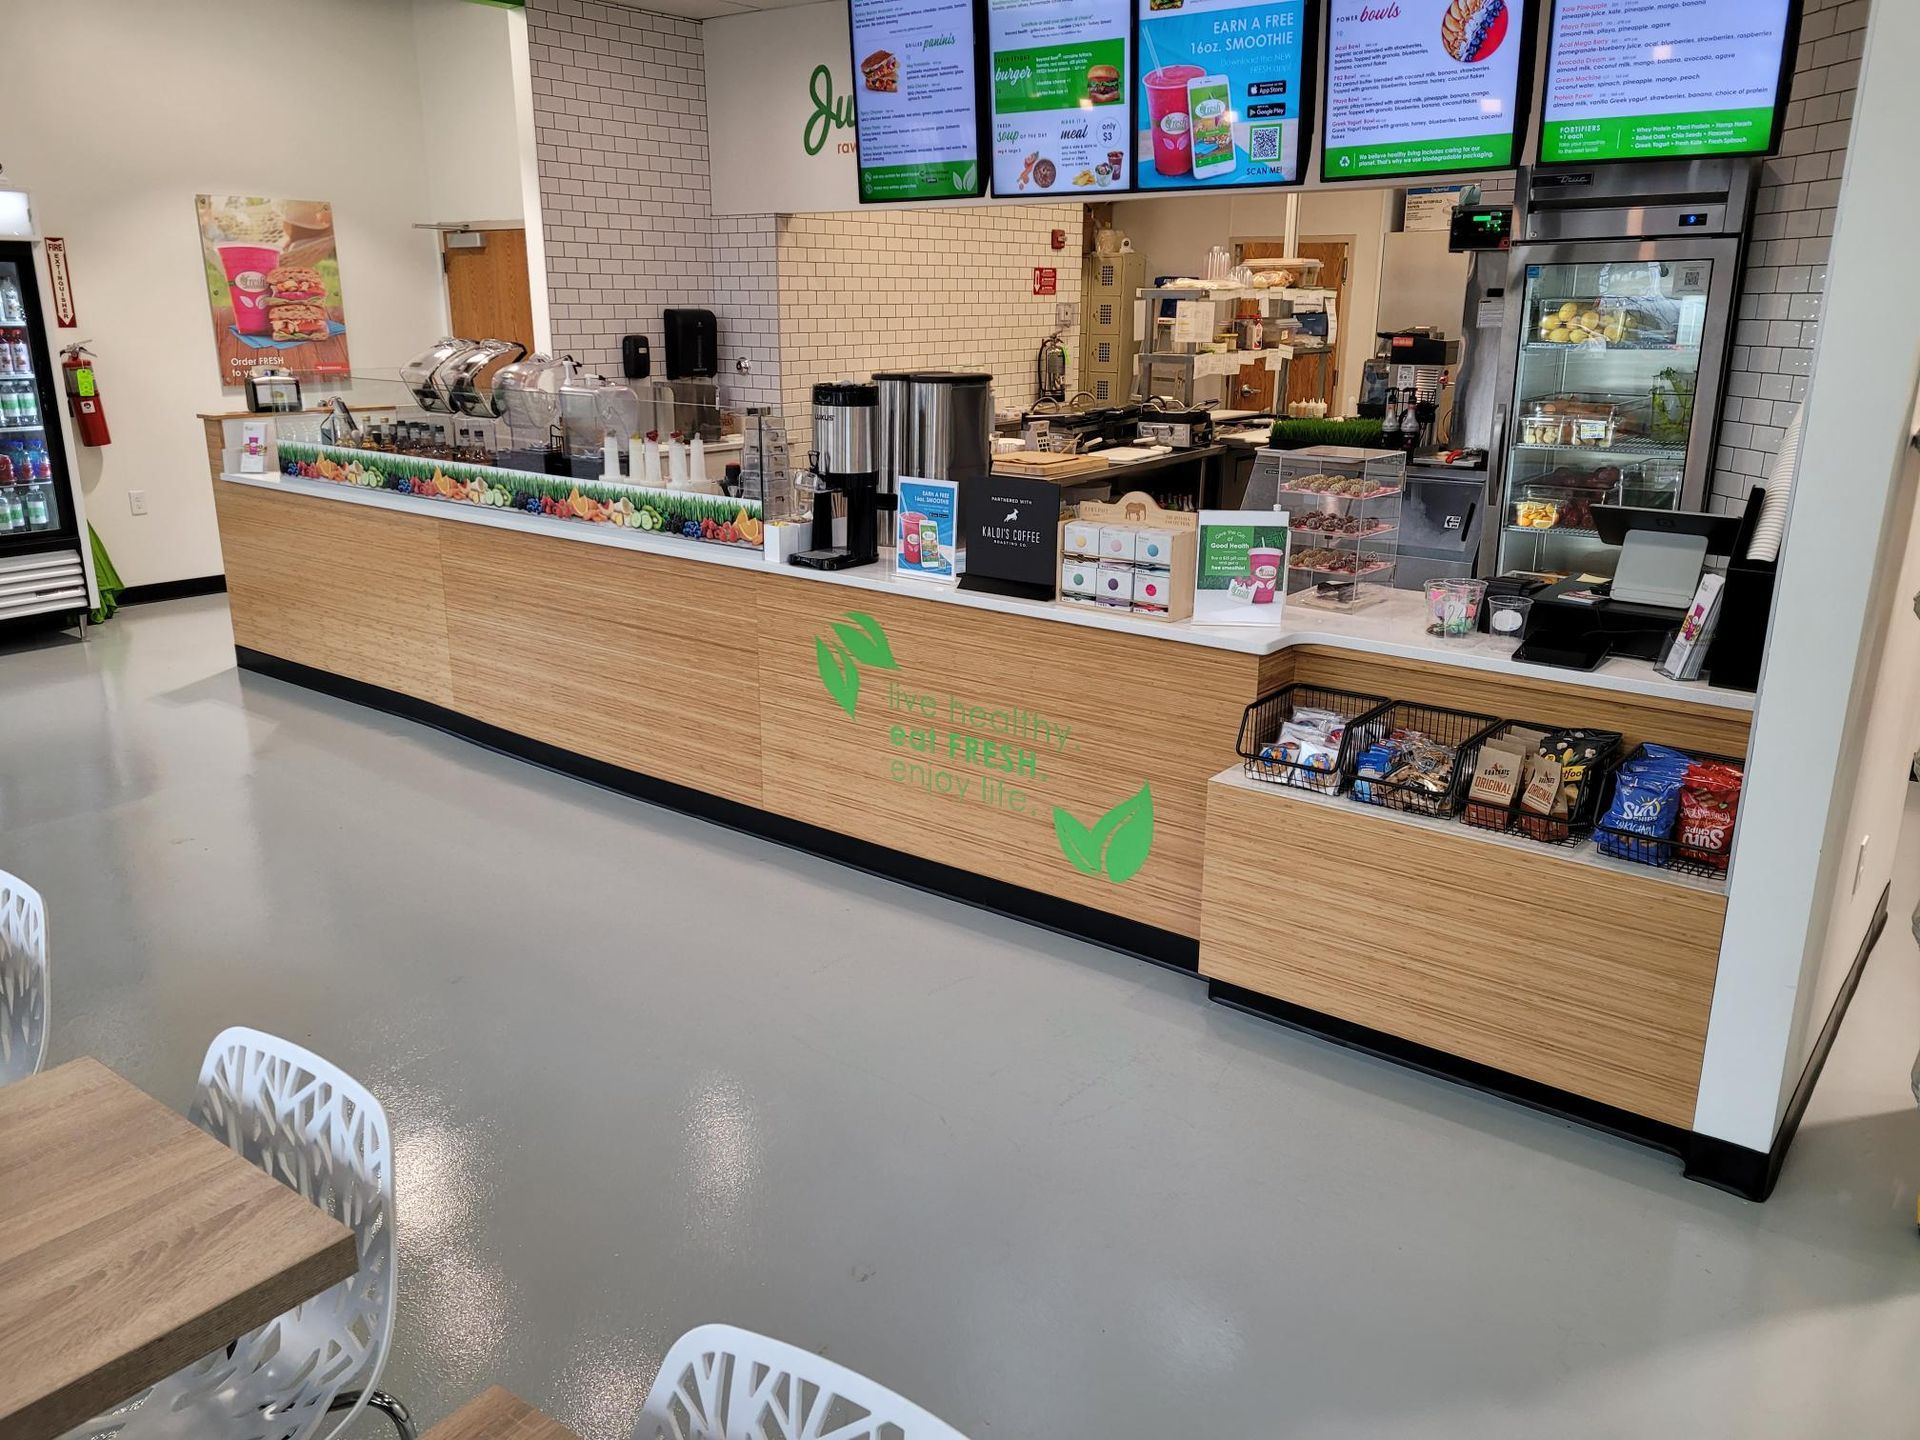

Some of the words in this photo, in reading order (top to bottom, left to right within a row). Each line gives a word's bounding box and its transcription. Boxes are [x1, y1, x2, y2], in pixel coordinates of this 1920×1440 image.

[1360, 2, 1401, 23] bowls
[1562, 10, 1591, 20] pineapple
[1214, 19, 1247, 34] EARN
[1251, 19, 1261, 29] A
[1265, 12, 1294, 27] FREE
[923, 33, 955, 51] paninis
[1191, 40, 1221, 55] 16oz.
[1225, 32, 1293, 51] SMOOTHIE
[1557, 63, 1579, 73] almond
[1593, 62, 1617, 70] coconut
[995, 65, 1032, 85] burger
[1554, 82, 1579, 90] coconut
[1061, 125, 1088, 140] meal
[1102, 122, 1116, 130] only
[1560, 125, 1601, 133] FORTIFIERS
[997, 131, 1019, 144] soup
[1103, 132, 1112, 142] $3
[1247, 167, 1266, 175] SCAN
[1270, 166, 1282, 174] ME!
[48, 242, 64, 253] FIRE
[54, 253, 69, 320] EXTINGUISHER
[231, 357, 256, 366] Order
[259, 357, 284, 365] FRESH
[232, 369, 241, 377] to
[245, 370, 256, 378] yo
[982, 526, 1010, 539] KALDI'S
[1013, 529, 1040, 543] COFFEE
[1215, 531, 1226, 539] Give
[887, 680, 937, 718] live
[949, 693, 1082, 752] healthy.
[889, 722, 937, 753] eat
[948, 732, 1049, 782] FRESH.
[889, 757, 970, 803] enjoy
[981, 775, 1037, 816] life.
[1475, 776, 1511, 795] ORIGINAL
[1527, 783, 1553, 804] ORIGINAL
[1685, 827, 1709, 836] CHIPS
